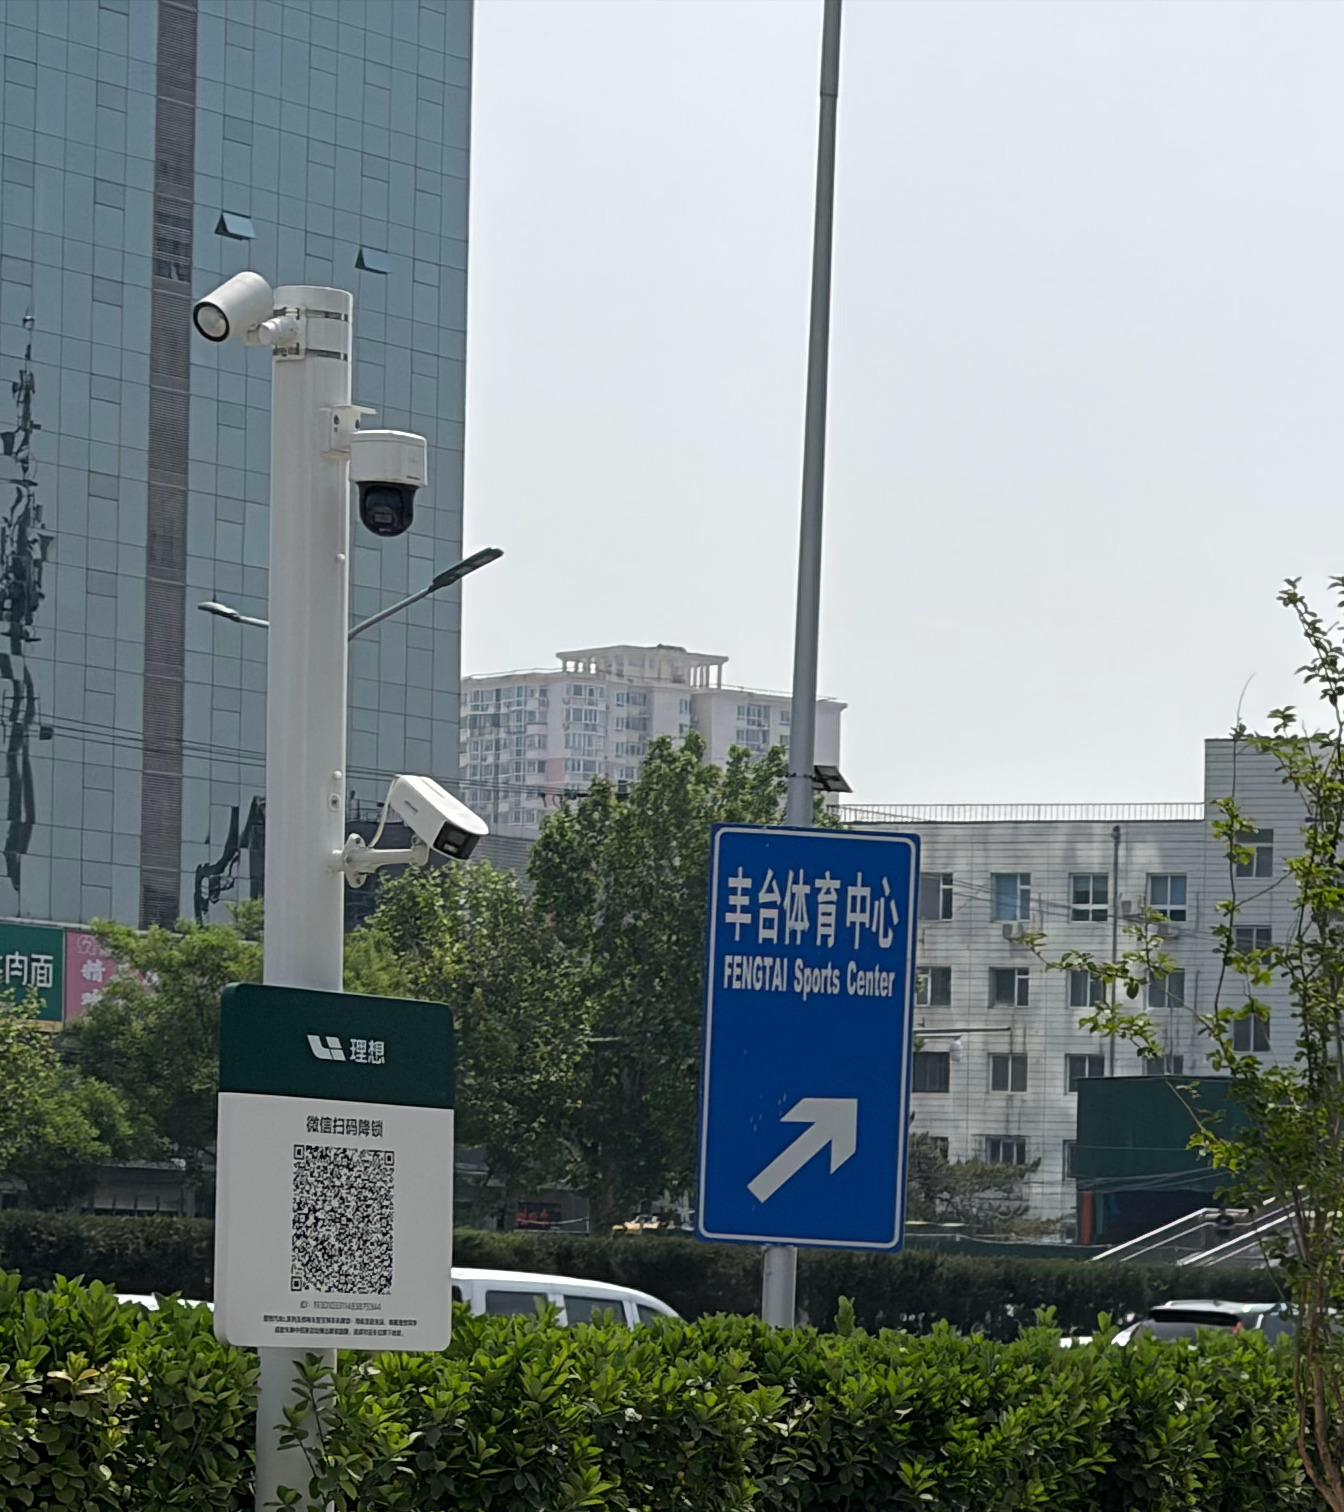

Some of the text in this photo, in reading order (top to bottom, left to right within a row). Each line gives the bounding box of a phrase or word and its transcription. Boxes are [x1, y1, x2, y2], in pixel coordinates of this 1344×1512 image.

[723, 866, 900, 950] 丰台体育中心
[0, 950, 54, 988] 肉面
[723, 954, 896, 1001] FENGTAI Sports Center
[349, 1038, 386, 1065] 理想
